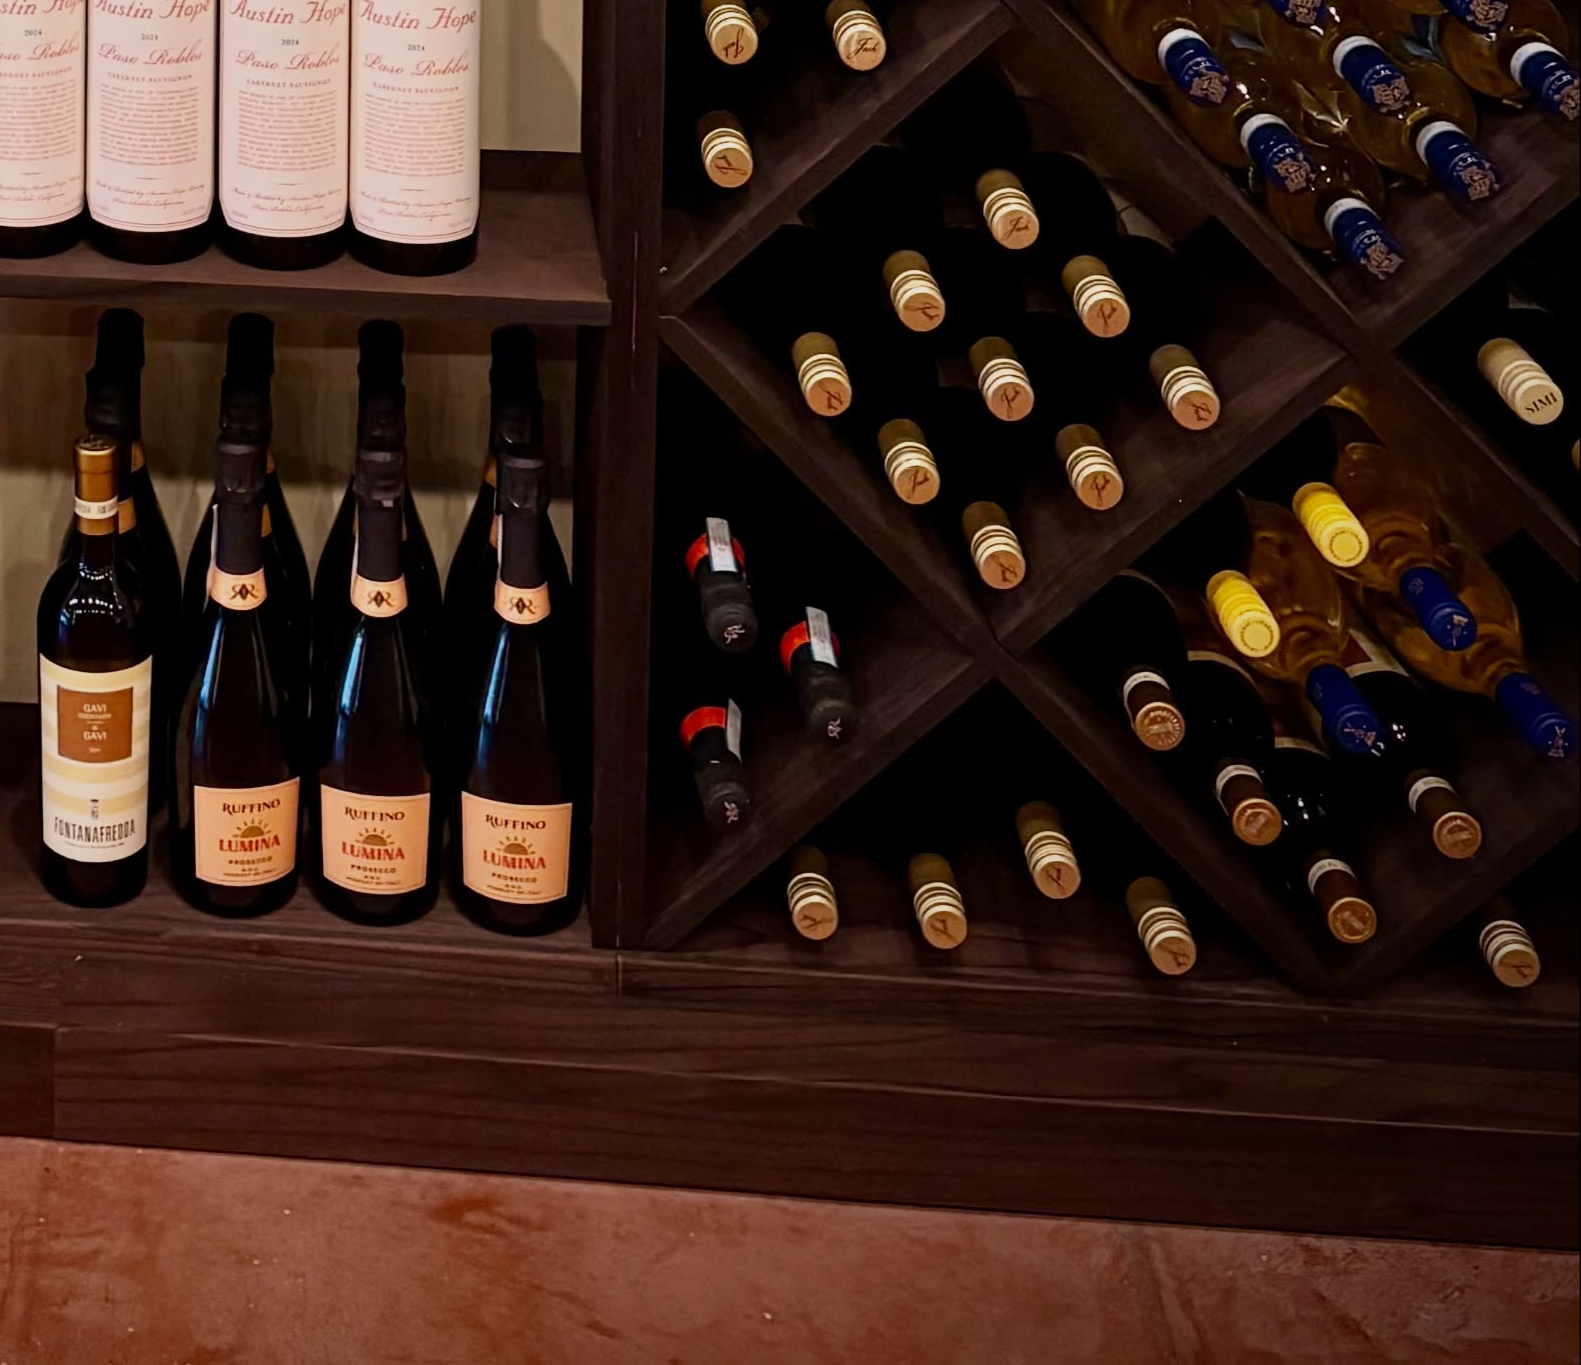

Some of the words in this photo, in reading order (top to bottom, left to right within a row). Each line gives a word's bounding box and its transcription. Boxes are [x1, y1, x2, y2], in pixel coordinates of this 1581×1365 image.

[299, 0, 347, 27] Hope
[426, 6, 478, 34] Hope
[26, 31, 79, 60] Robles
[98, 43, 138, 64] Paso
[142, 38, 202, 65] Robles
[235, 49, 279, 69] Paso
[284, 42, 340, 70] Robles
[363, 52, 404, 75] Paso
[410, 50, 469, 76] Robles
[1525, 391, 1559, 414] SIMI
[83, 703, 107, 713] GAVI
[83, 731, 107, 741] GAVI
[222, 798, 281, 816] RUFFINO
[345, 806, 405, 821] RUFFINO
[54, 816, 136, 843] FONTANAFREDDA
[485, 814, 546, 830] RUFFINO
[219, 833, 281, 852] LUMINA
[342, 841, 405, 861] LUMINA
[350, 864, 396, 874] PROSECCO
[483, 849, 547, 869] LUMINA
[491, 872, 538, 883] PROSECCO
